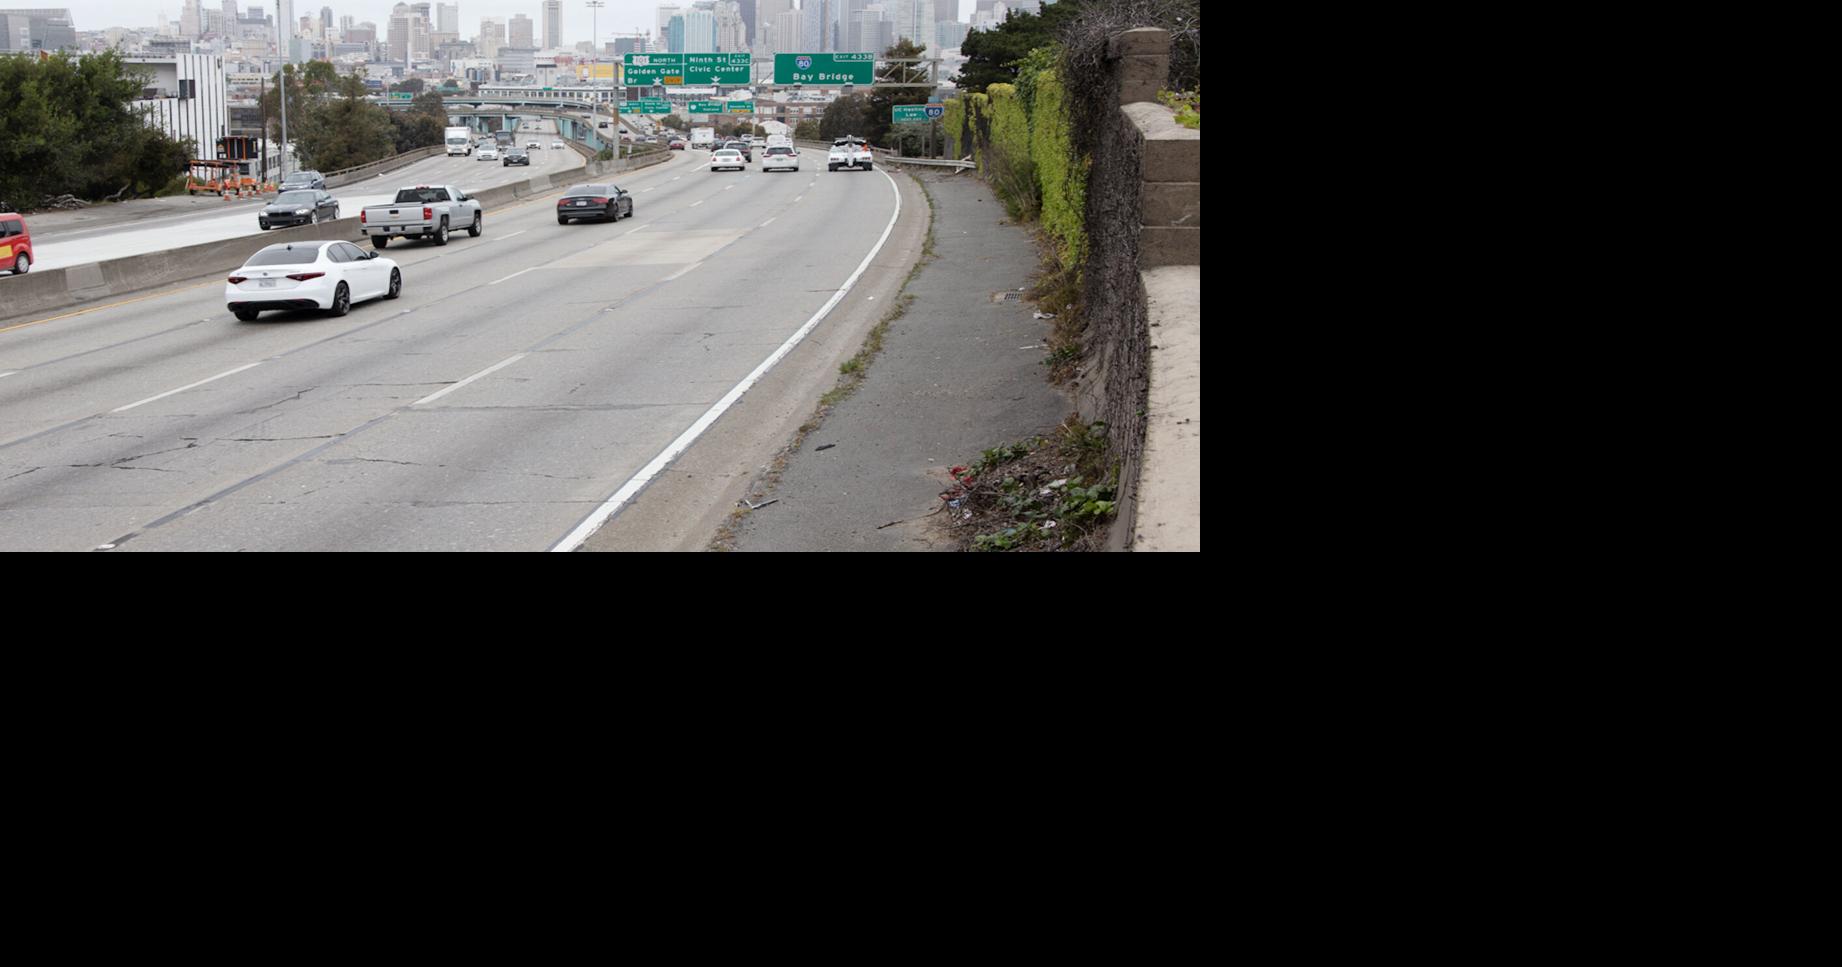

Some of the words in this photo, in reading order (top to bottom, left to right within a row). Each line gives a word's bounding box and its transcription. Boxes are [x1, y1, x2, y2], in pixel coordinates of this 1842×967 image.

[689, 65, 711, 73] Civic
[714, 65, 744, 73] Center
[792, 73, 814, 81] Bay
[818, 73, 854, 81] Bridge
